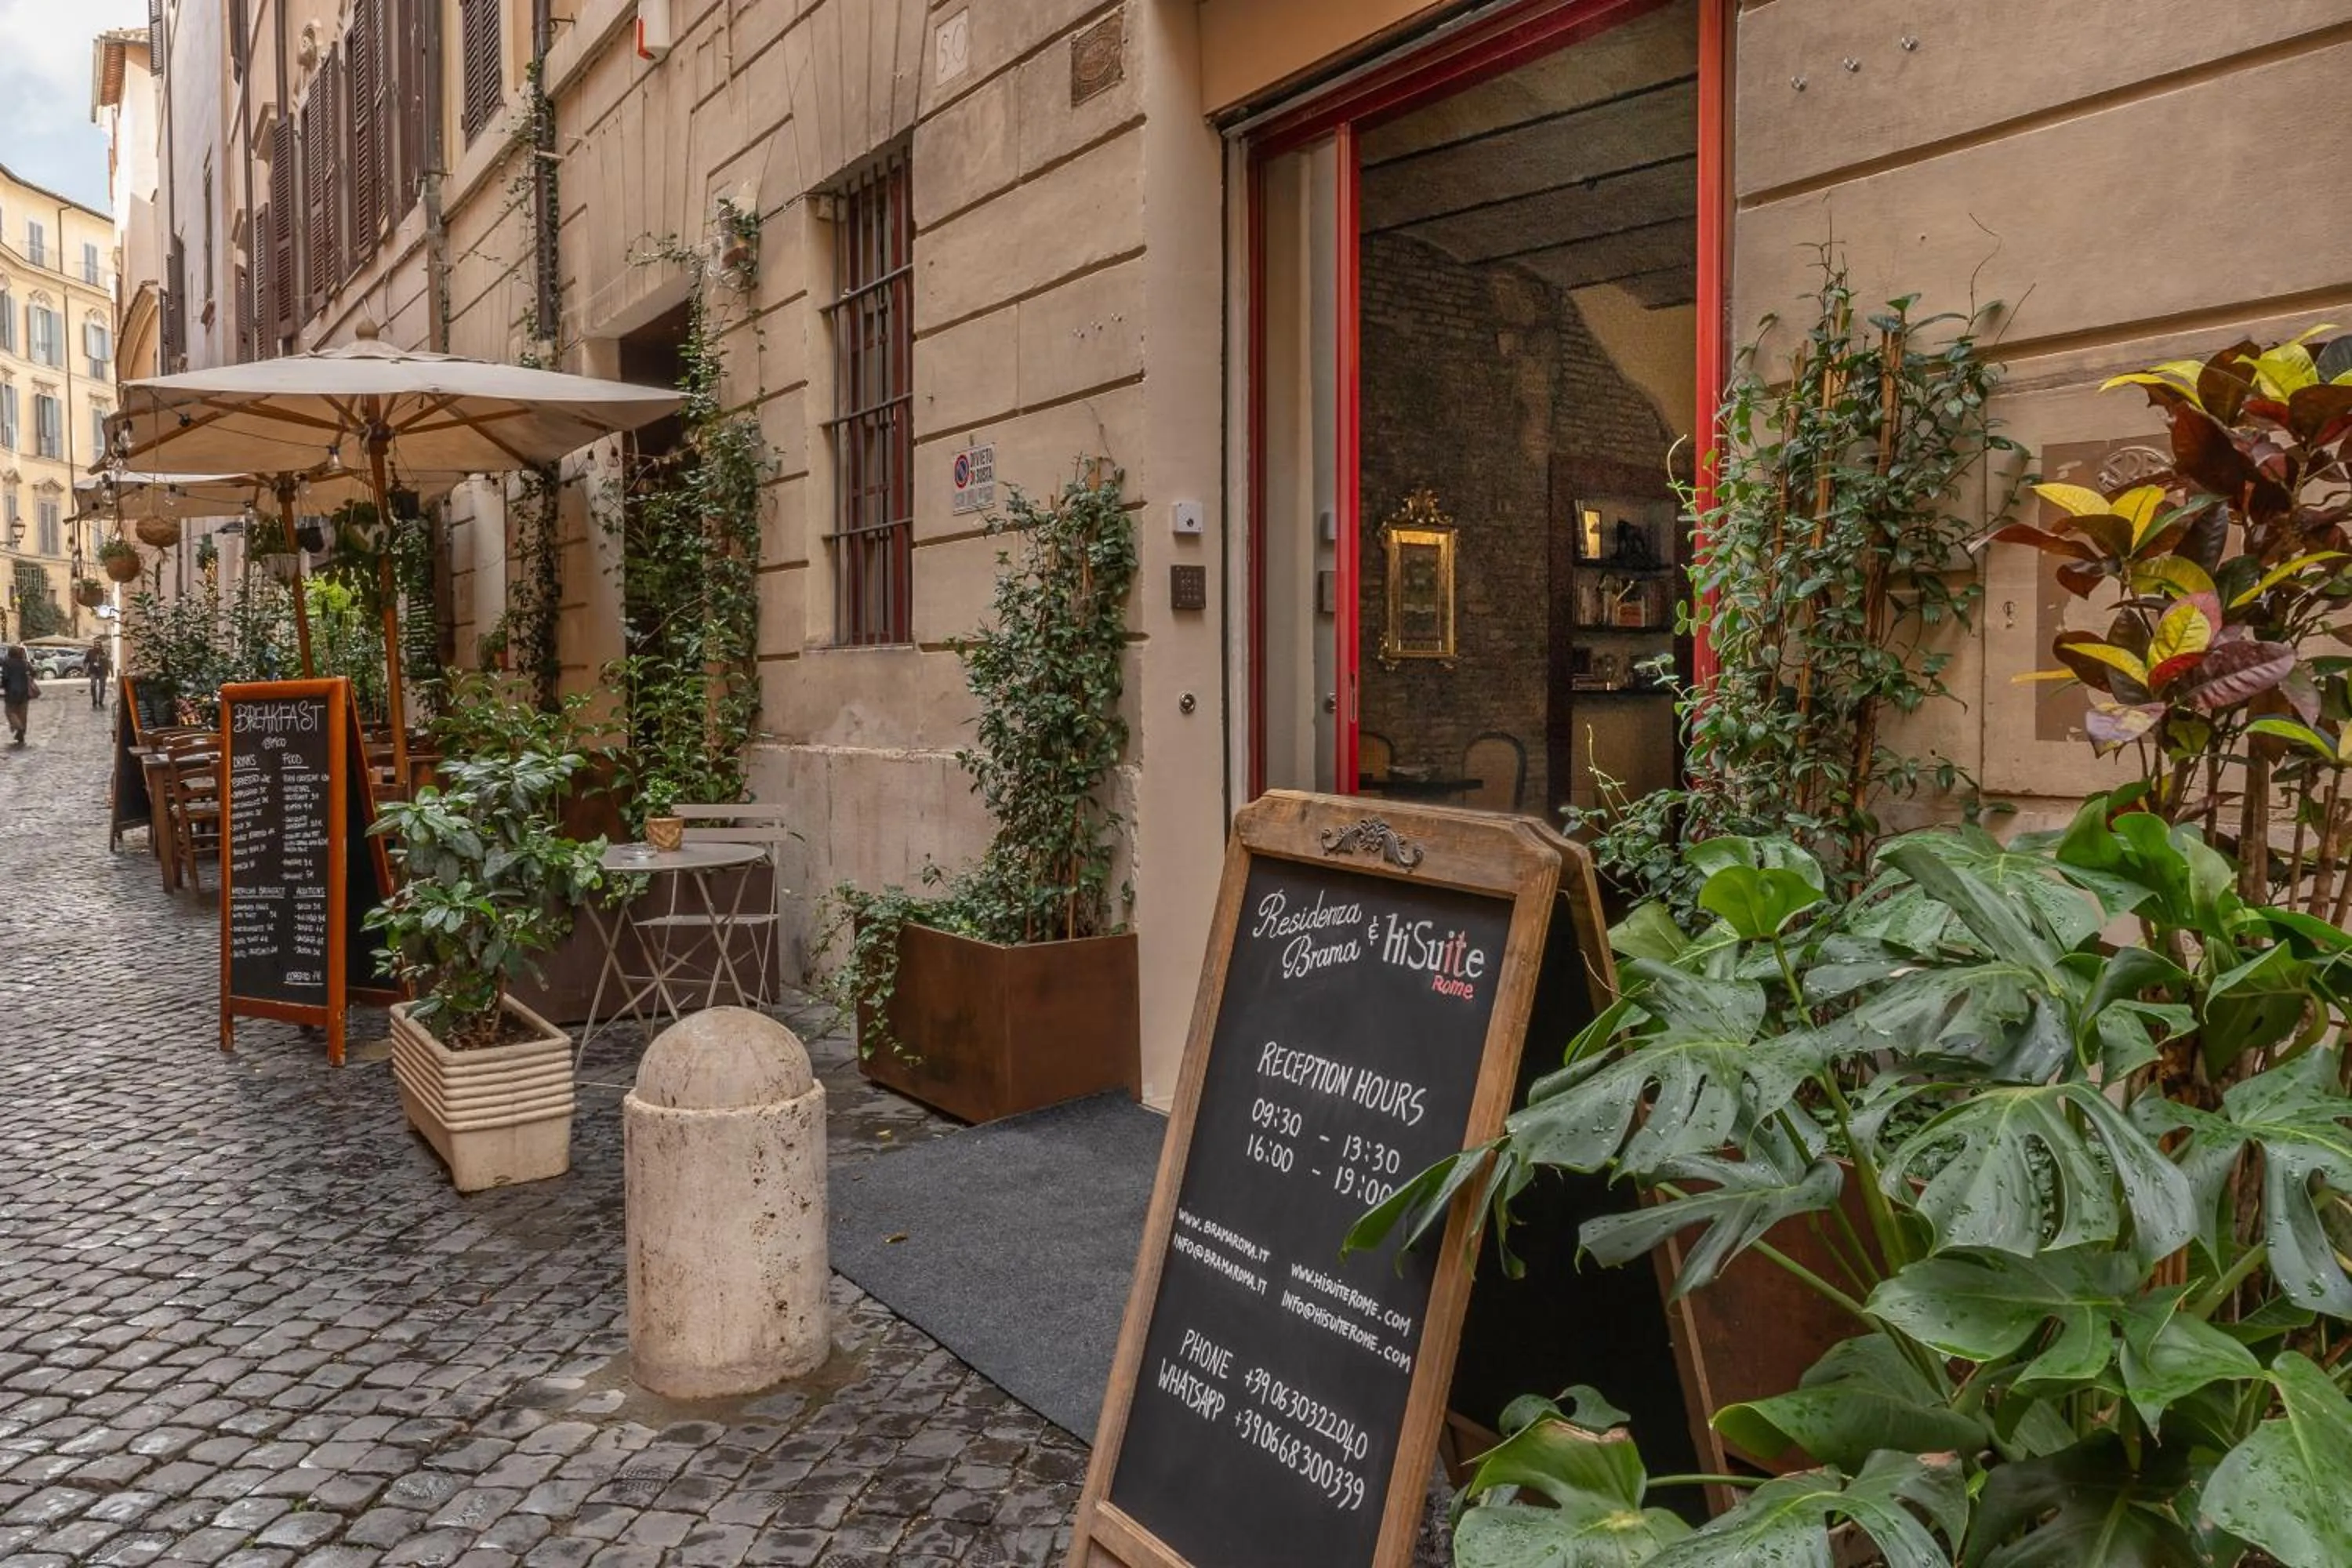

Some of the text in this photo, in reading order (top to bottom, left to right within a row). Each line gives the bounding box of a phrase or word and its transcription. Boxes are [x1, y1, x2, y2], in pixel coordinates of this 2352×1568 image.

[970, 448, 992, 468] DIVIETO
[976, 465, 992, 485] SOSTA
[233, 700, 326, 733] BREAKFAST
[1252, 887, 1363, 939] Residenza
[1282, 933, 1362, 979] Brama
[1431, 975, 1474, 1001] Rome
[1257, 1040, 1427, 1127] RECEPTION HOURS
[1247, 1133, 1294, 1173] 16:00
[1251, 1098, 1302, 1138] 09:30
[1342, 1134, 1400, 1174] 13:30
[1179, 1329, 1233, 1379] PHONE
[1157, 1357, 1226, 1422] WHATSAPP
